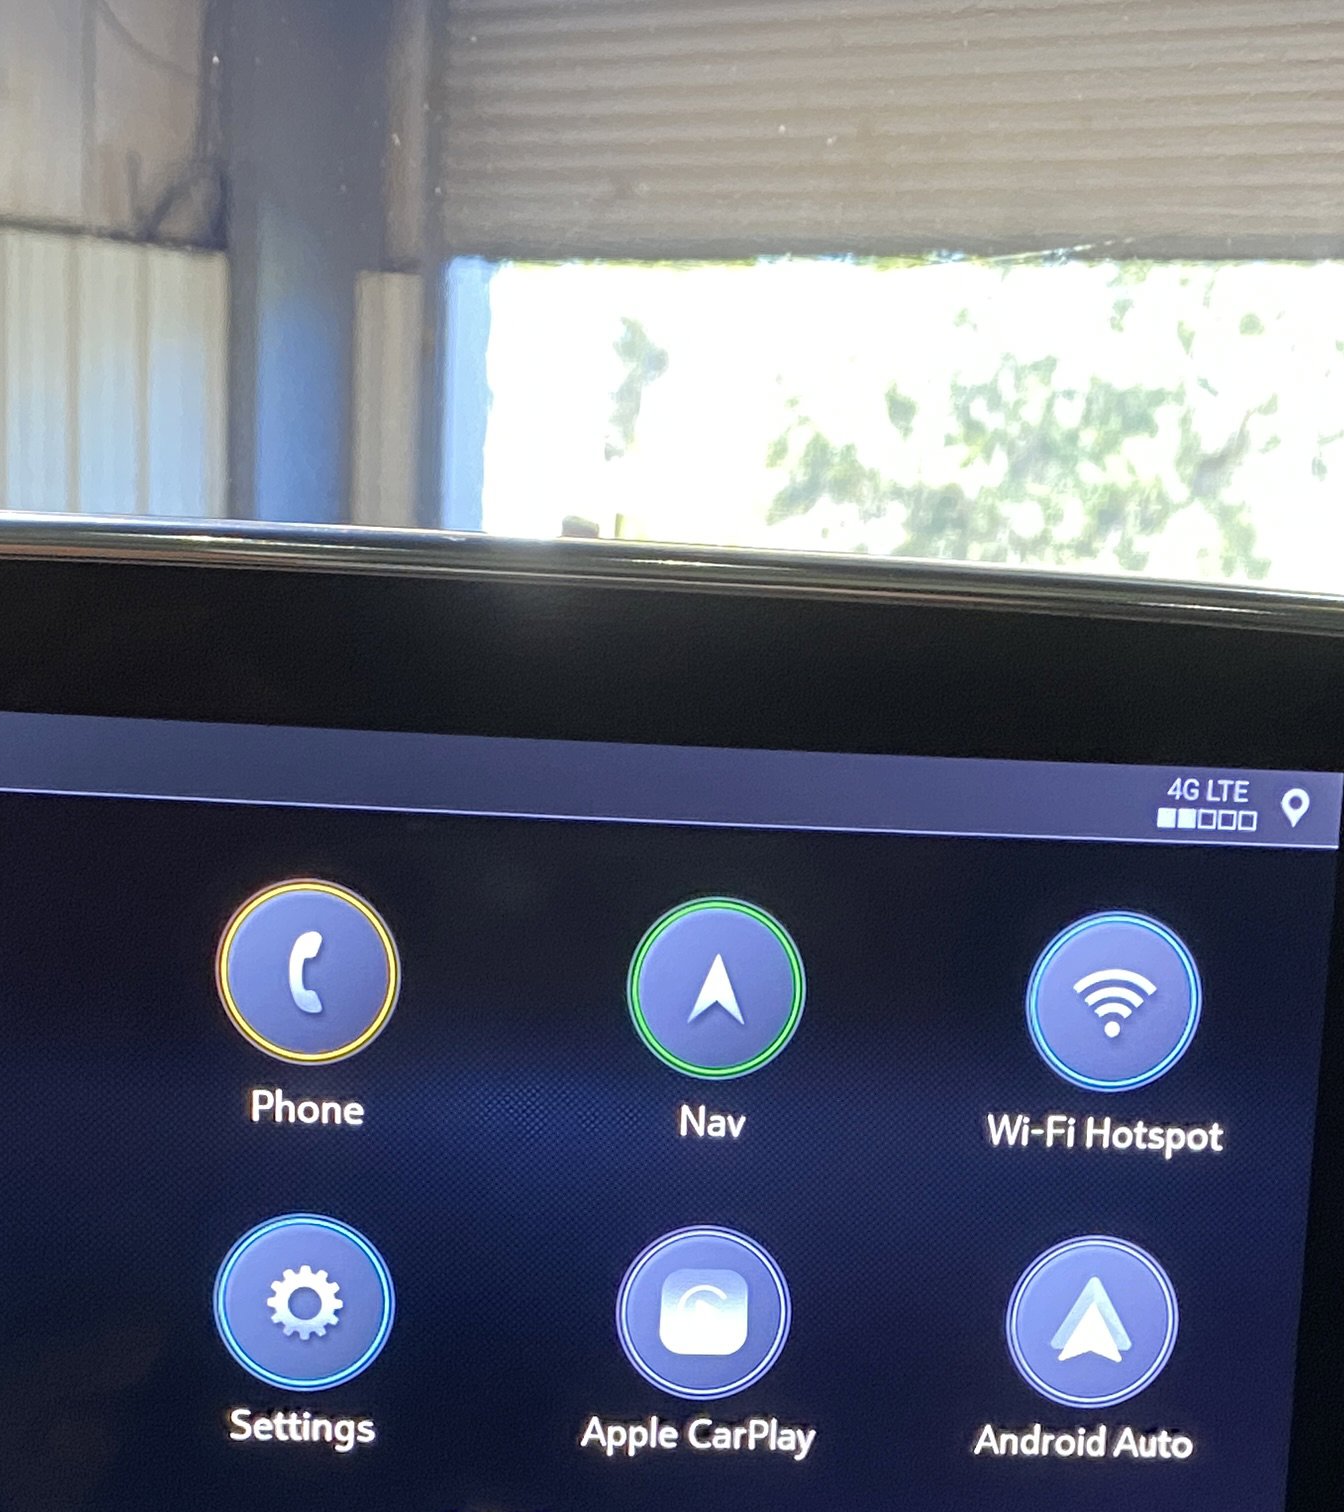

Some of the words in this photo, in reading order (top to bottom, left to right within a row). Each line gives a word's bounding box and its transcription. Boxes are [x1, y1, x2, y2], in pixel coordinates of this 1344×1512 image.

[1165, 776, 1201, 802] 4G
[1205, 778, 1251, 804] LTE
[250, 1087, 366, 1127] Phone
[678, 1103, 748, 1140] Nav
[986, 1112, 1077, 1150] Wi-Fi
[1084, 1115, 1225, 1162] Hotspot
[228, 1407, 377, 1454] Settings
[579, 1414, 680, 1458] Apple
[686, 1416, 818, 1462] CarPlay
[972, 1422, 1108, 1459] Android
[1112, 1425, 1195, 1460] Auto
